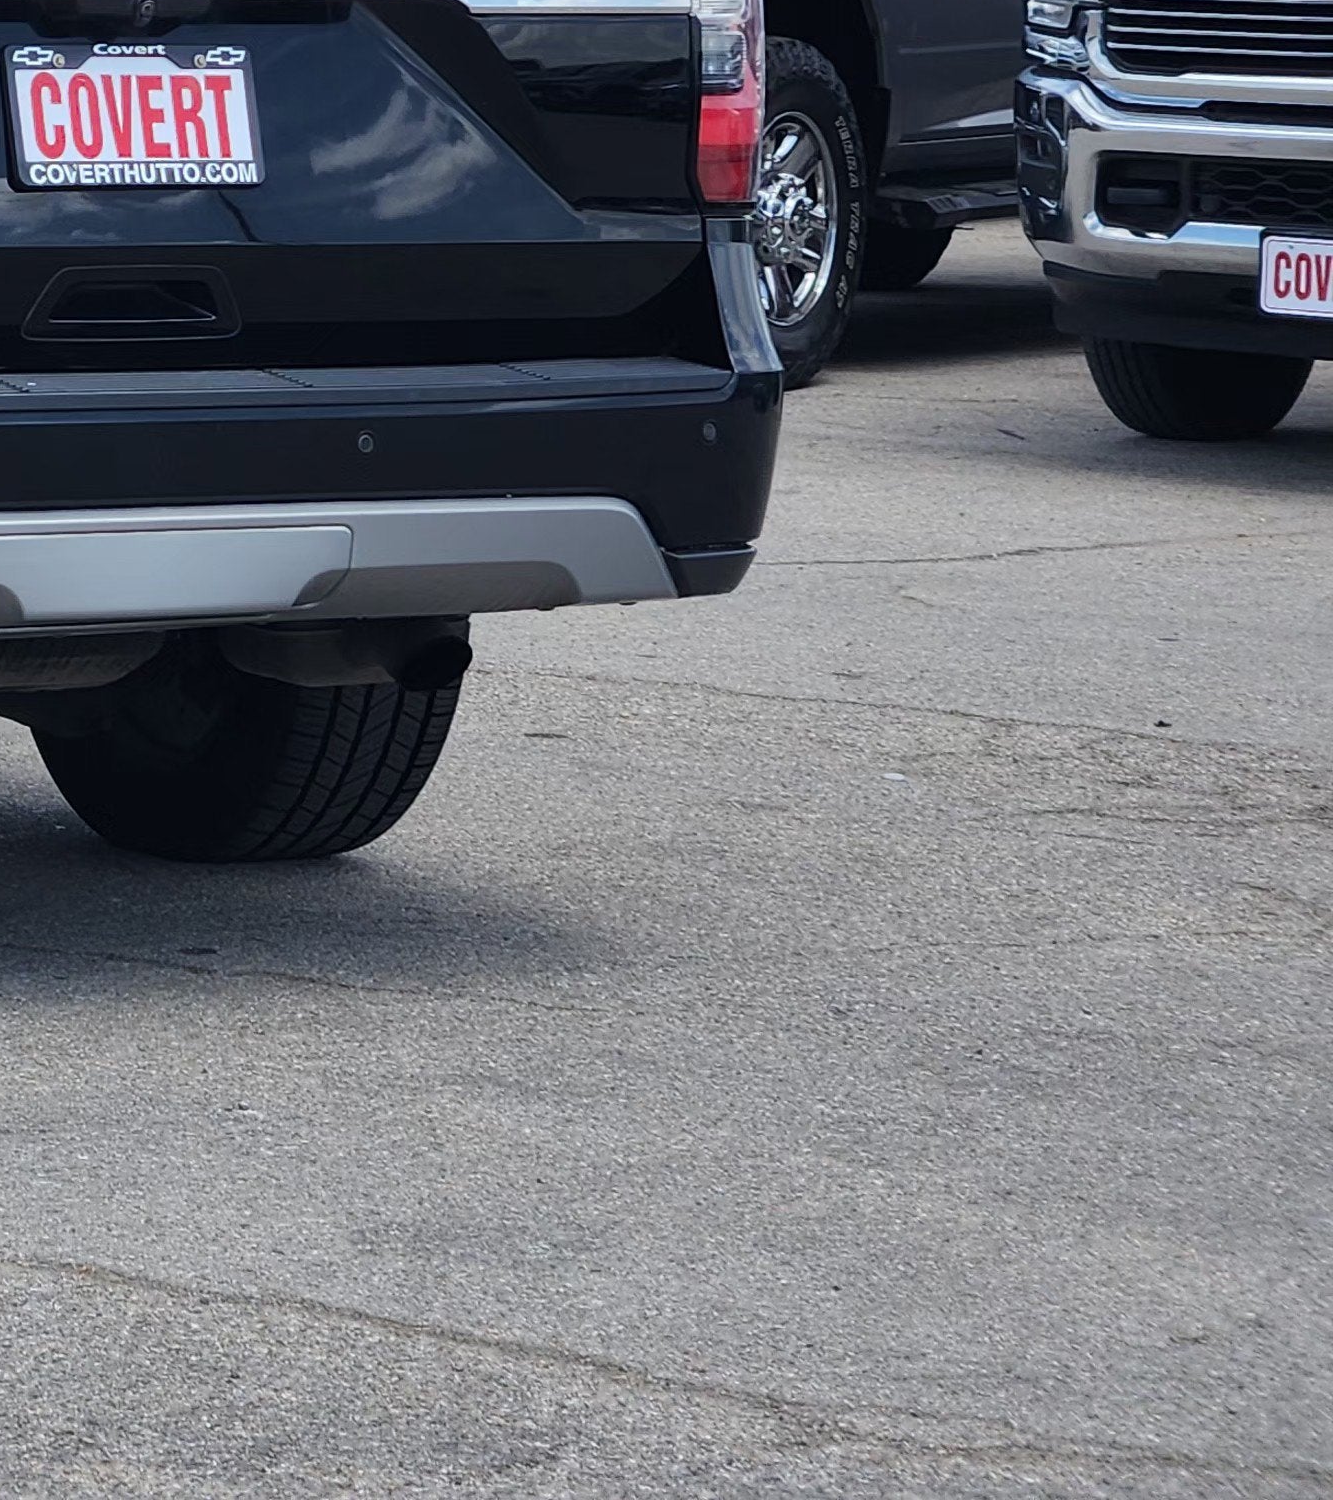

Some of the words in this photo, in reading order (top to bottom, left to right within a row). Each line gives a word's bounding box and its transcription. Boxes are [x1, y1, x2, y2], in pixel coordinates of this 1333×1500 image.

[93, 43, 166, 55] Covert
[31, 71, 232, 159] COVERT
[30, 163, 258, 185] COVERTHUTTO.COM
